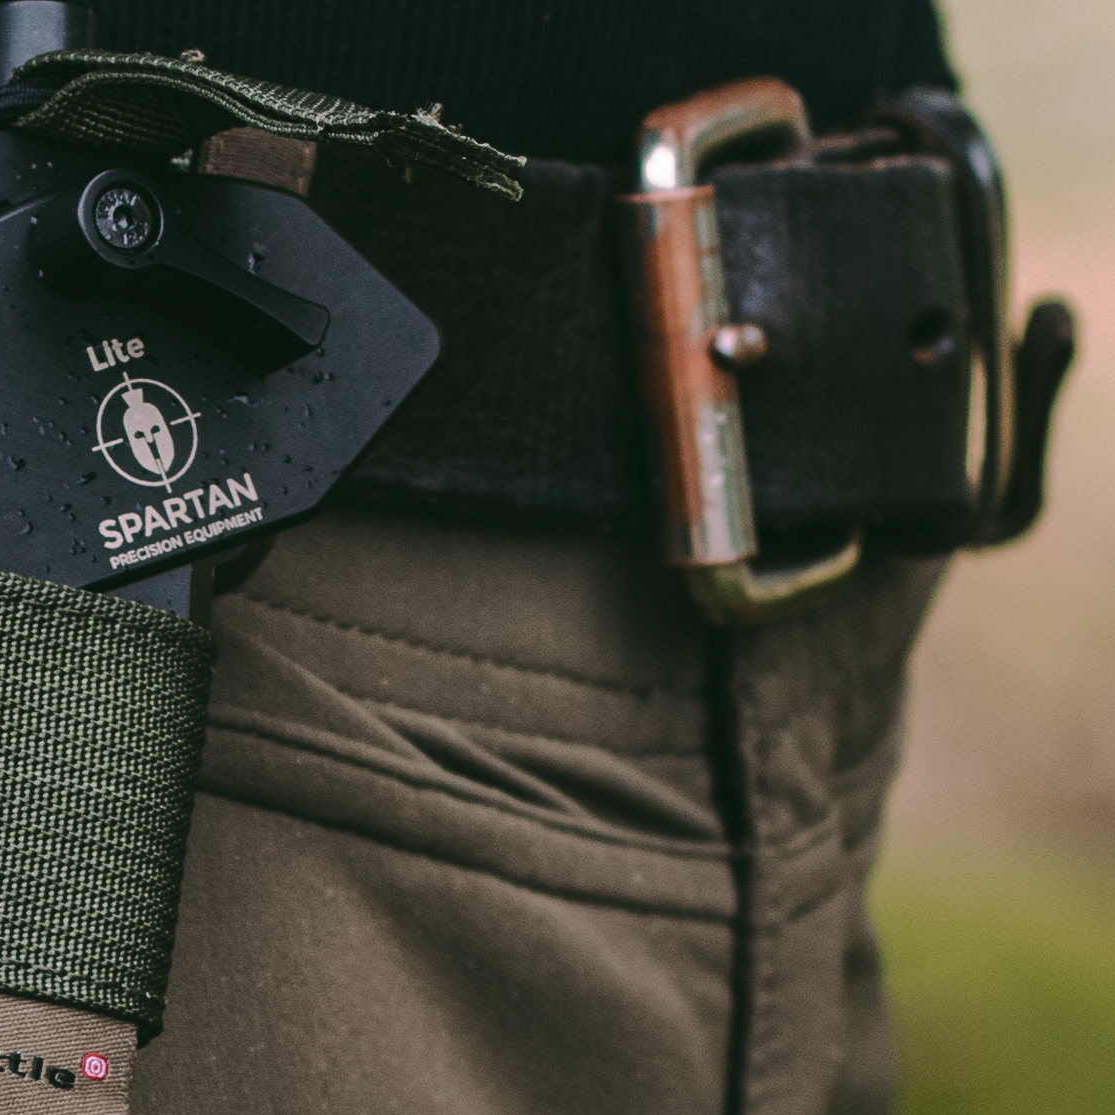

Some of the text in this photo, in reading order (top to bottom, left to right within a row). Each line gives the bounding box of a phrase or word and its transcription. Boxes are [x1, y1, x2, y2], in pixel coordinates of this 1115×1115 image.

[87, 338, 145, 371] Lite
[98, 473, 258, 549] SPARTAN
[109, 507, 263, 569] PRECISION EQUIPMENT
